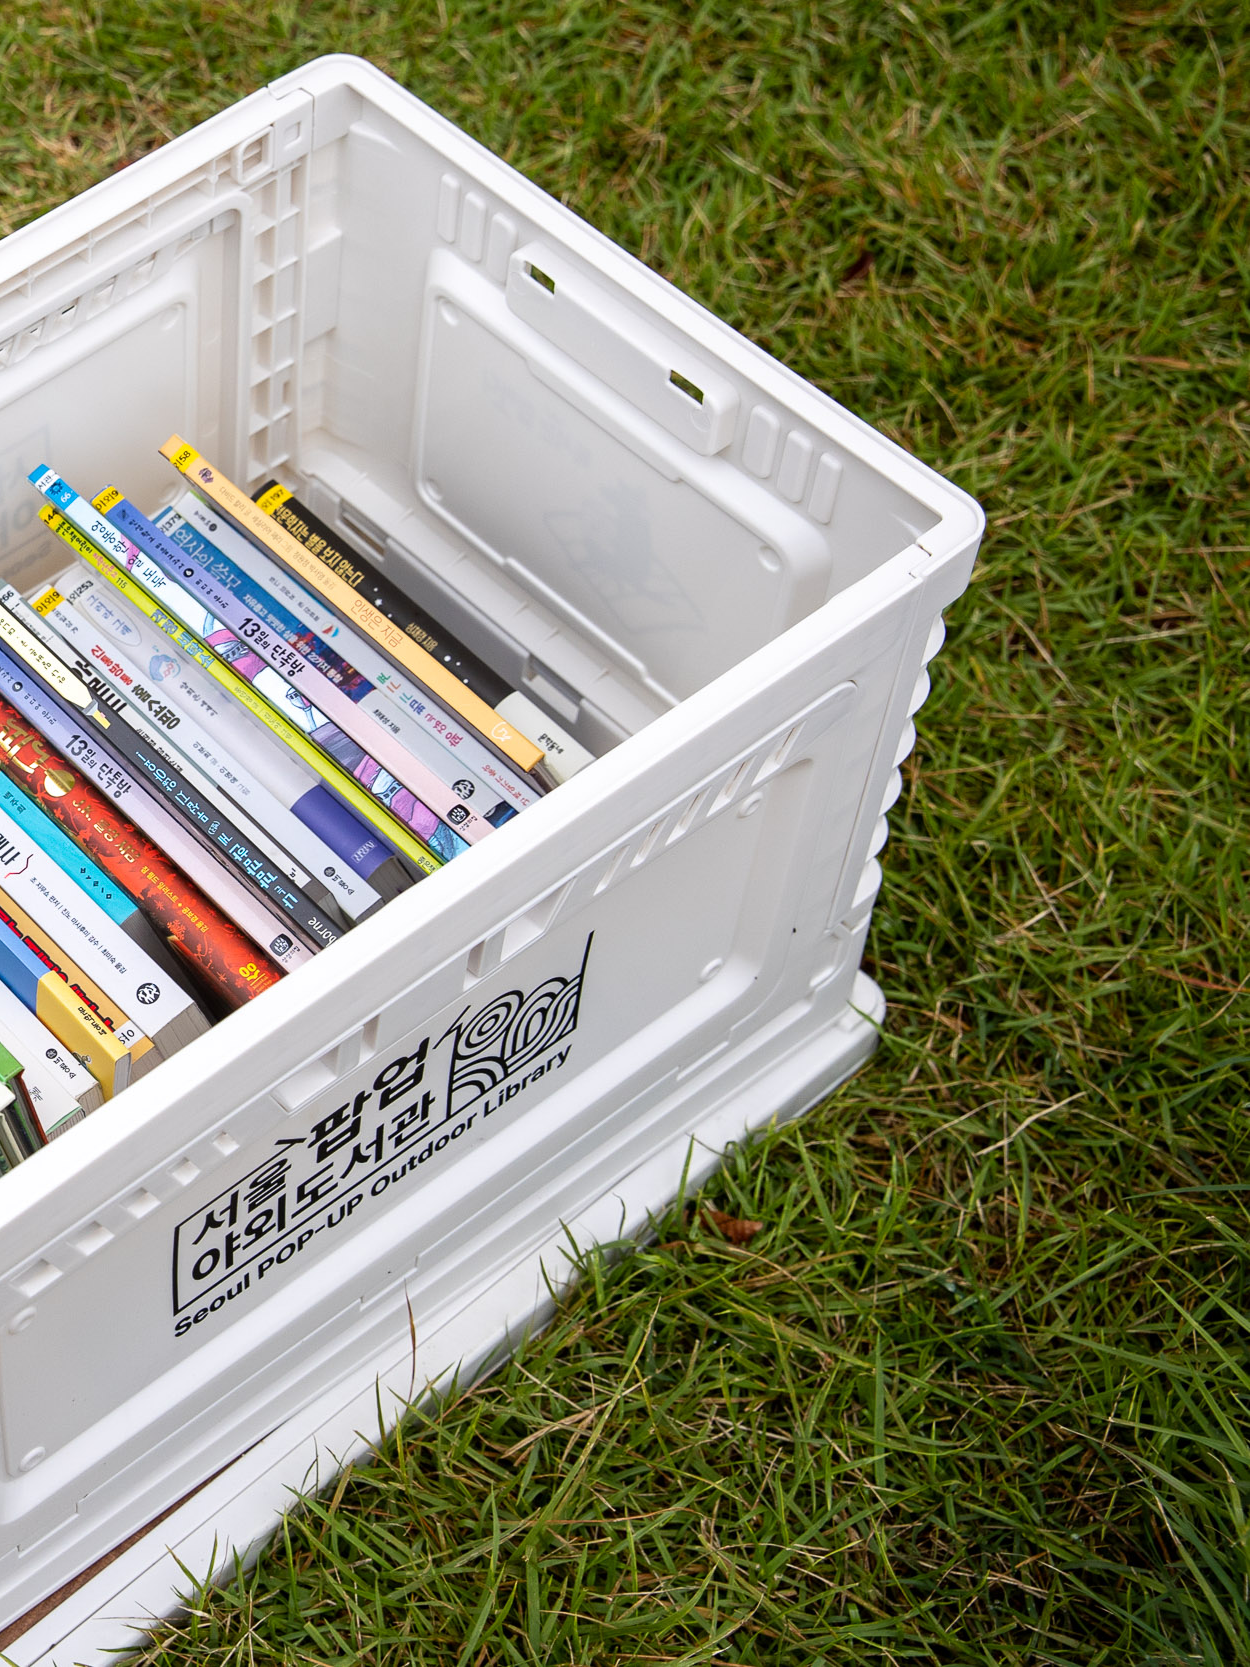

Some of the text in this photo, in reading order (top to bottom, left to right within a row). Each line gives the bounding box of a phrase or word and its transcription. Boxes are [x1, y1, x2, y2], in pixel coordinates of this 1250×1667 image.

[60, 492, 72, 503] 66
[173, 527, 215, 567] 역사의
[305, 532, 327, 555] 별을
[319, 546, 343, 569] 보지
[335, 559, 365, 587] 않는다
[116, 577, 128, 589] 115
[150, 608, 216, 669] 걱정 세탁소
[351, 599, 404, 648] 인생은 지금
[238, 617, 306, 678] 13일의 단톡방
[424, 712, 447, 733] 없는
[444, 730, 464, 747] 꽝
[538, 733, 564, 754] 문학동네
[65, 734, 98, 769] 13일의
[97, 762, 132, 799] 단톡방
[175, 789, 210, 824] 무섭지
[93, 819, 119, 843] 롤링
[229, 843, 278, 889] 깜깜한
[53, 1057, 77, 1079] 비룡소
[191, 1036, 431, 1246] 서울 팝업
[174, 1043, 573, 1339] Seoul POP-UP Outdoor Library
[191, 1092, 436, 1282] 야외도서관
